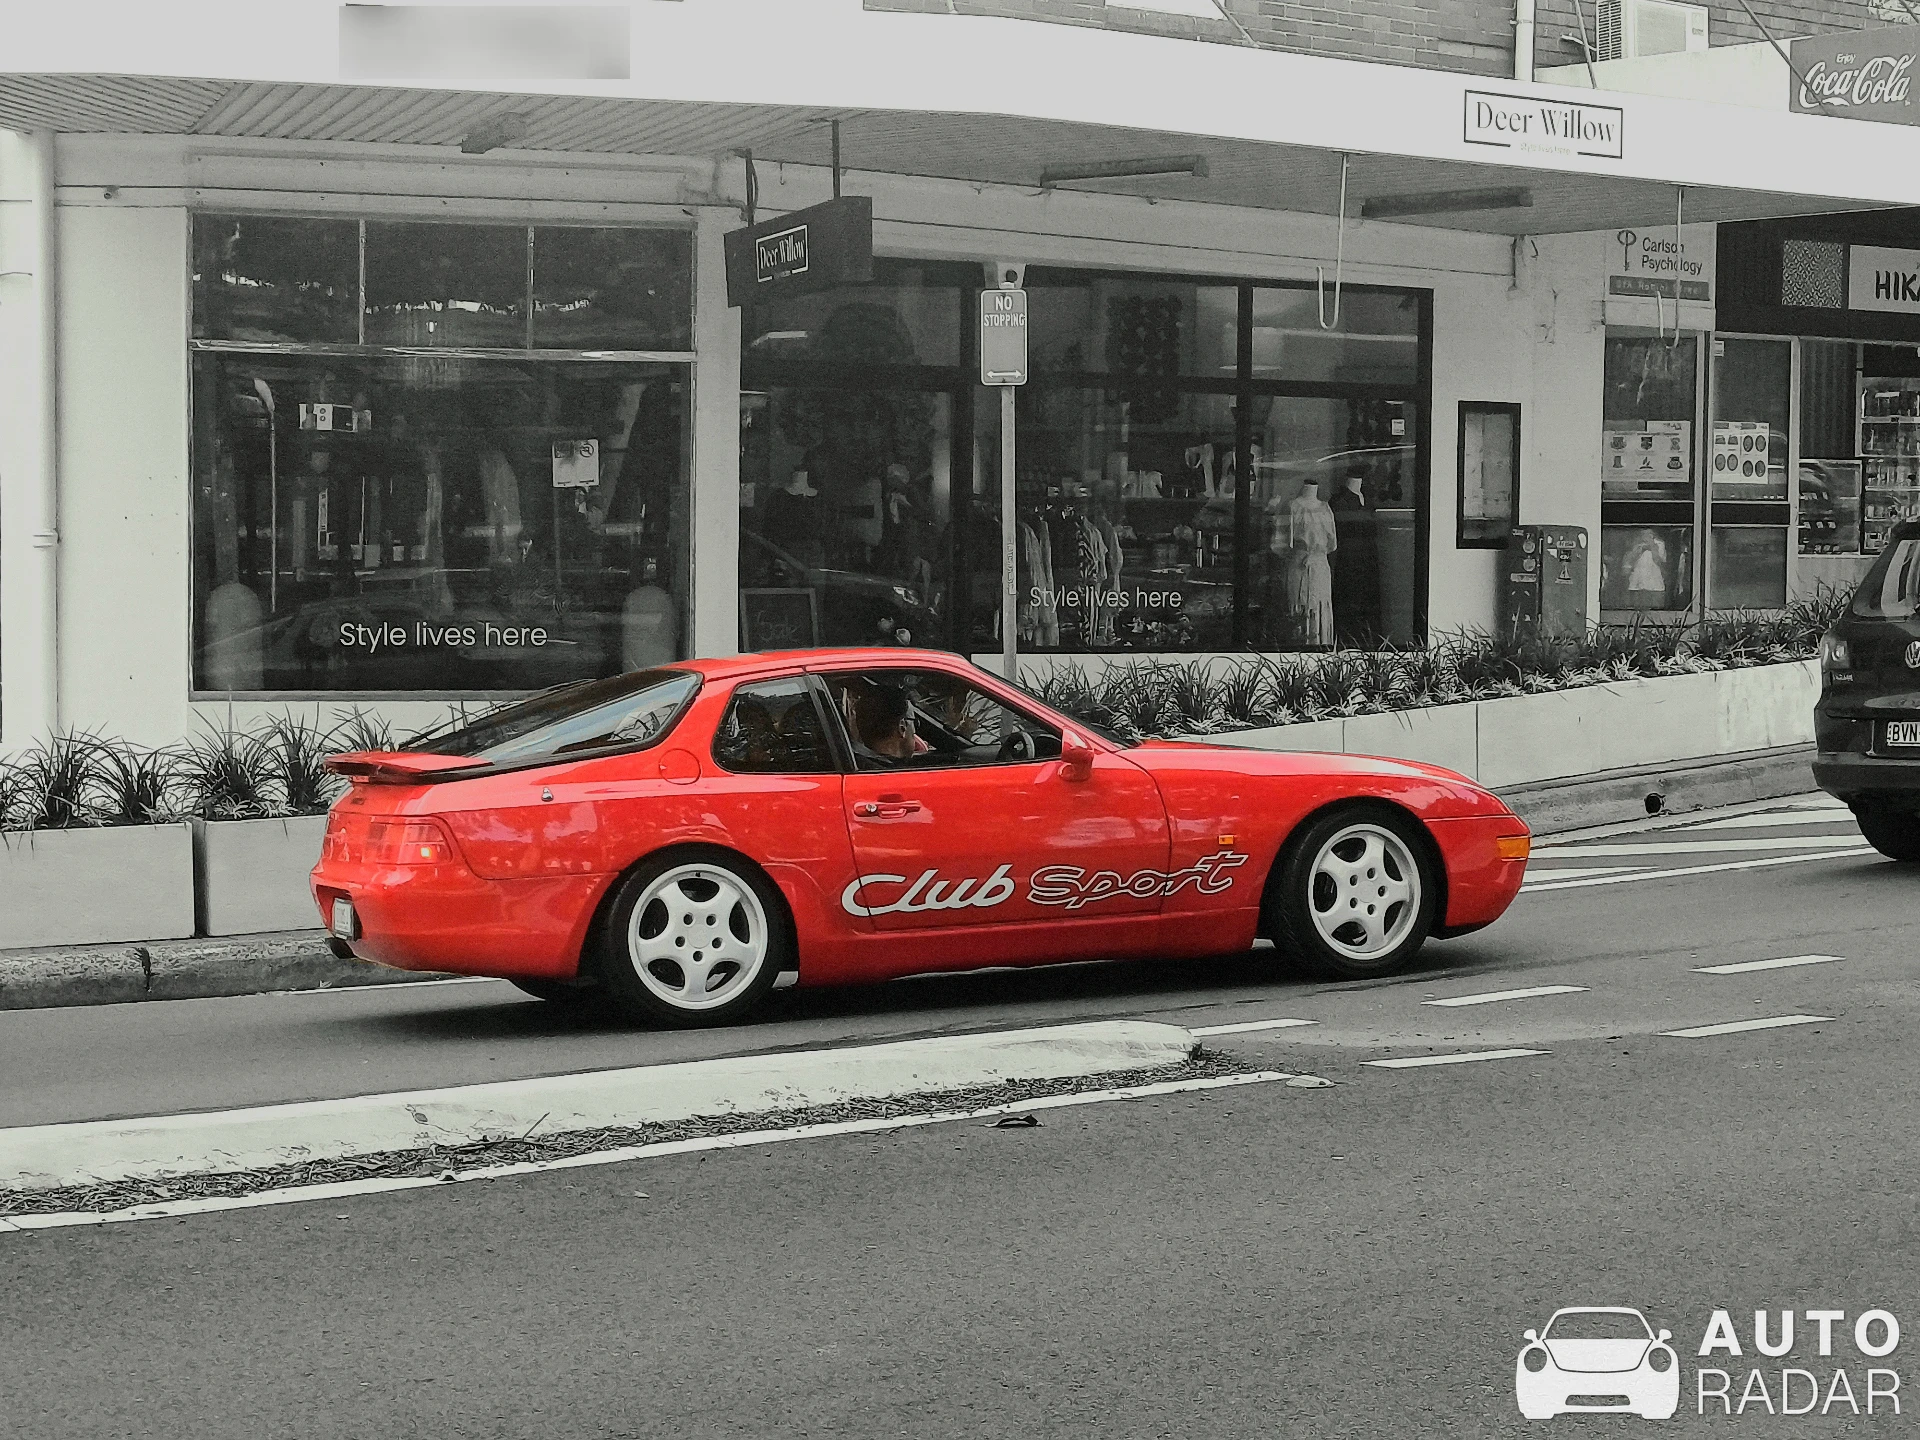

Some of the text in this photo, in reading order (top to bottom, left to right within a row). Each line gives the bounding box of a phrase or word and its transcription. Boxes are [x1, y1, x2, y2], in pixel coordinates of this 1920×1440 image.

[1836, 53, 1856, 65] Enjoy
[1800, 54, 1917, 108] Coca-Cola
[1476, 101, 1615, 144] Deer Willow
[760, 234, 805, 269] Deer Willow
[1642, 237, 1685, 254] Carlson
[1641, 255, 1703, 276] Psychology
[1875, 270, 1920, 303] HIK
[995, 296, 1013, 311] NO
[983, 313, 1026, 327] STOPPING
[1030, 585, 1183, 614] Style lives here
[339, 620, 548, 654] Style lives here
[841, 850, 1250, 917] Club Sport
